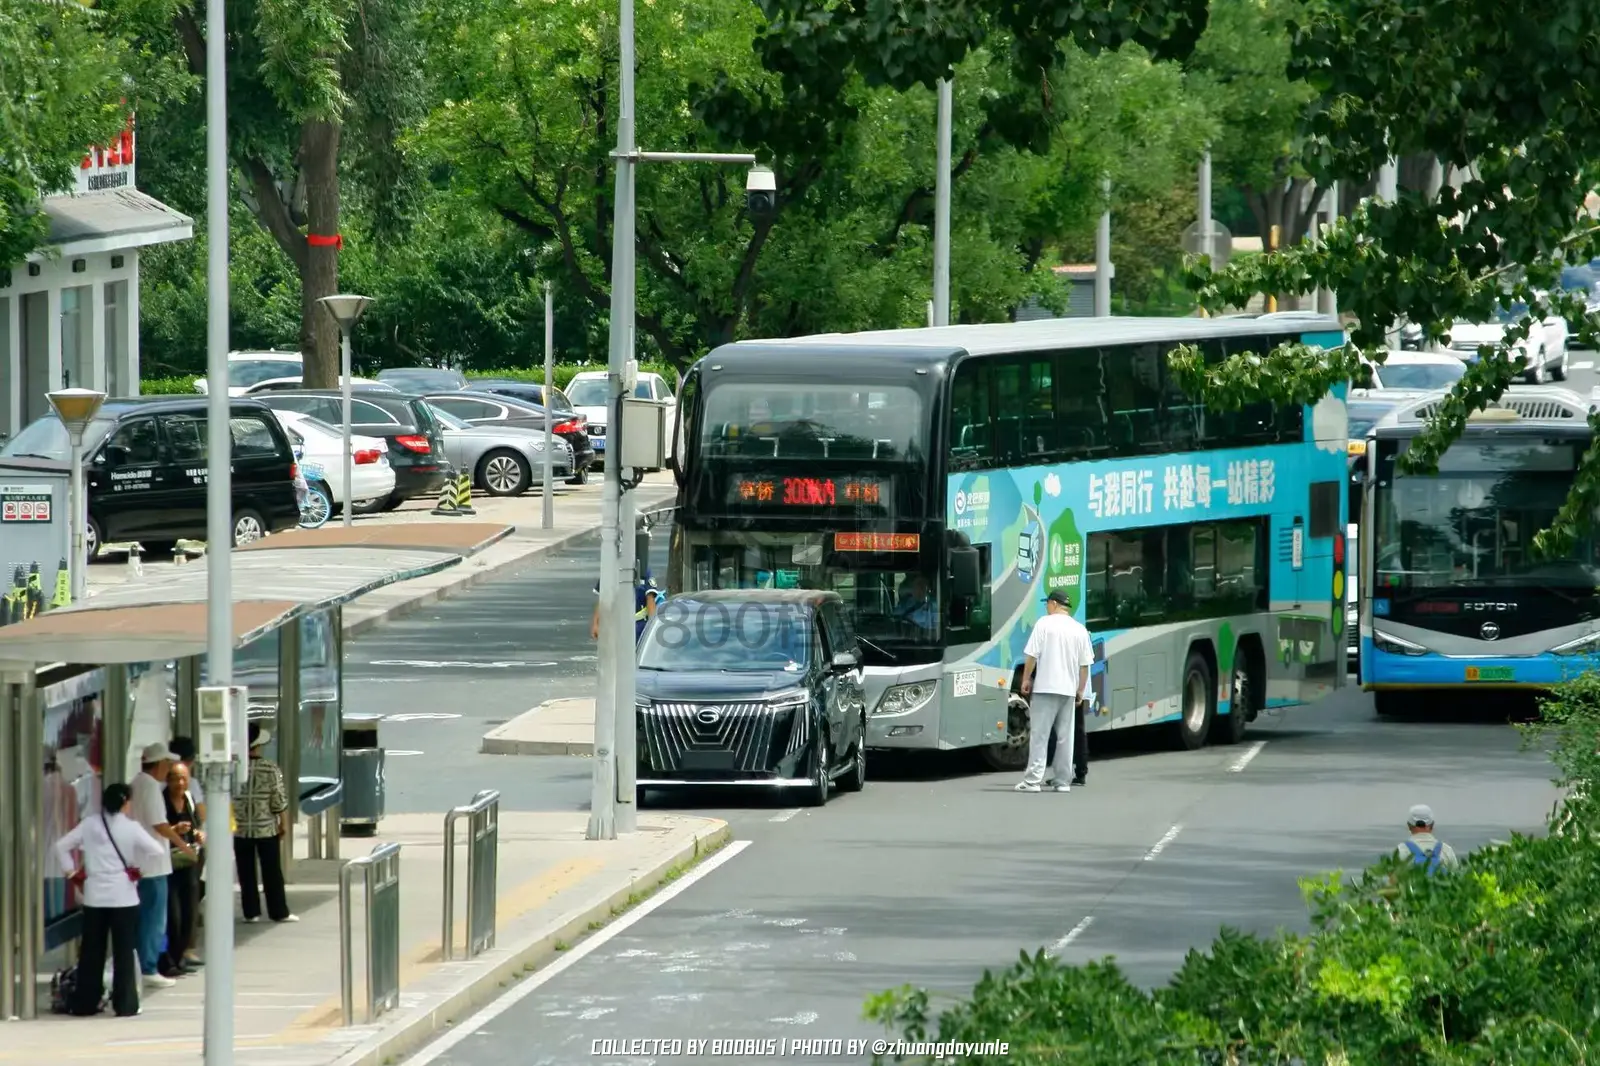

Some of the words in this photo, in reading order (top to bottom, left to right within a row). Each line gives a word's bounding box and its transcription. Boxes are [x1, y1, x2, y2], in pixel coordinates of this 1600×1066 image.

[1088, 470, 1153, 517] 与我同行
[1163, 459, 1275, 511] 共赴每一站精彩
[1464, 602, 1518, 611] FOTON
